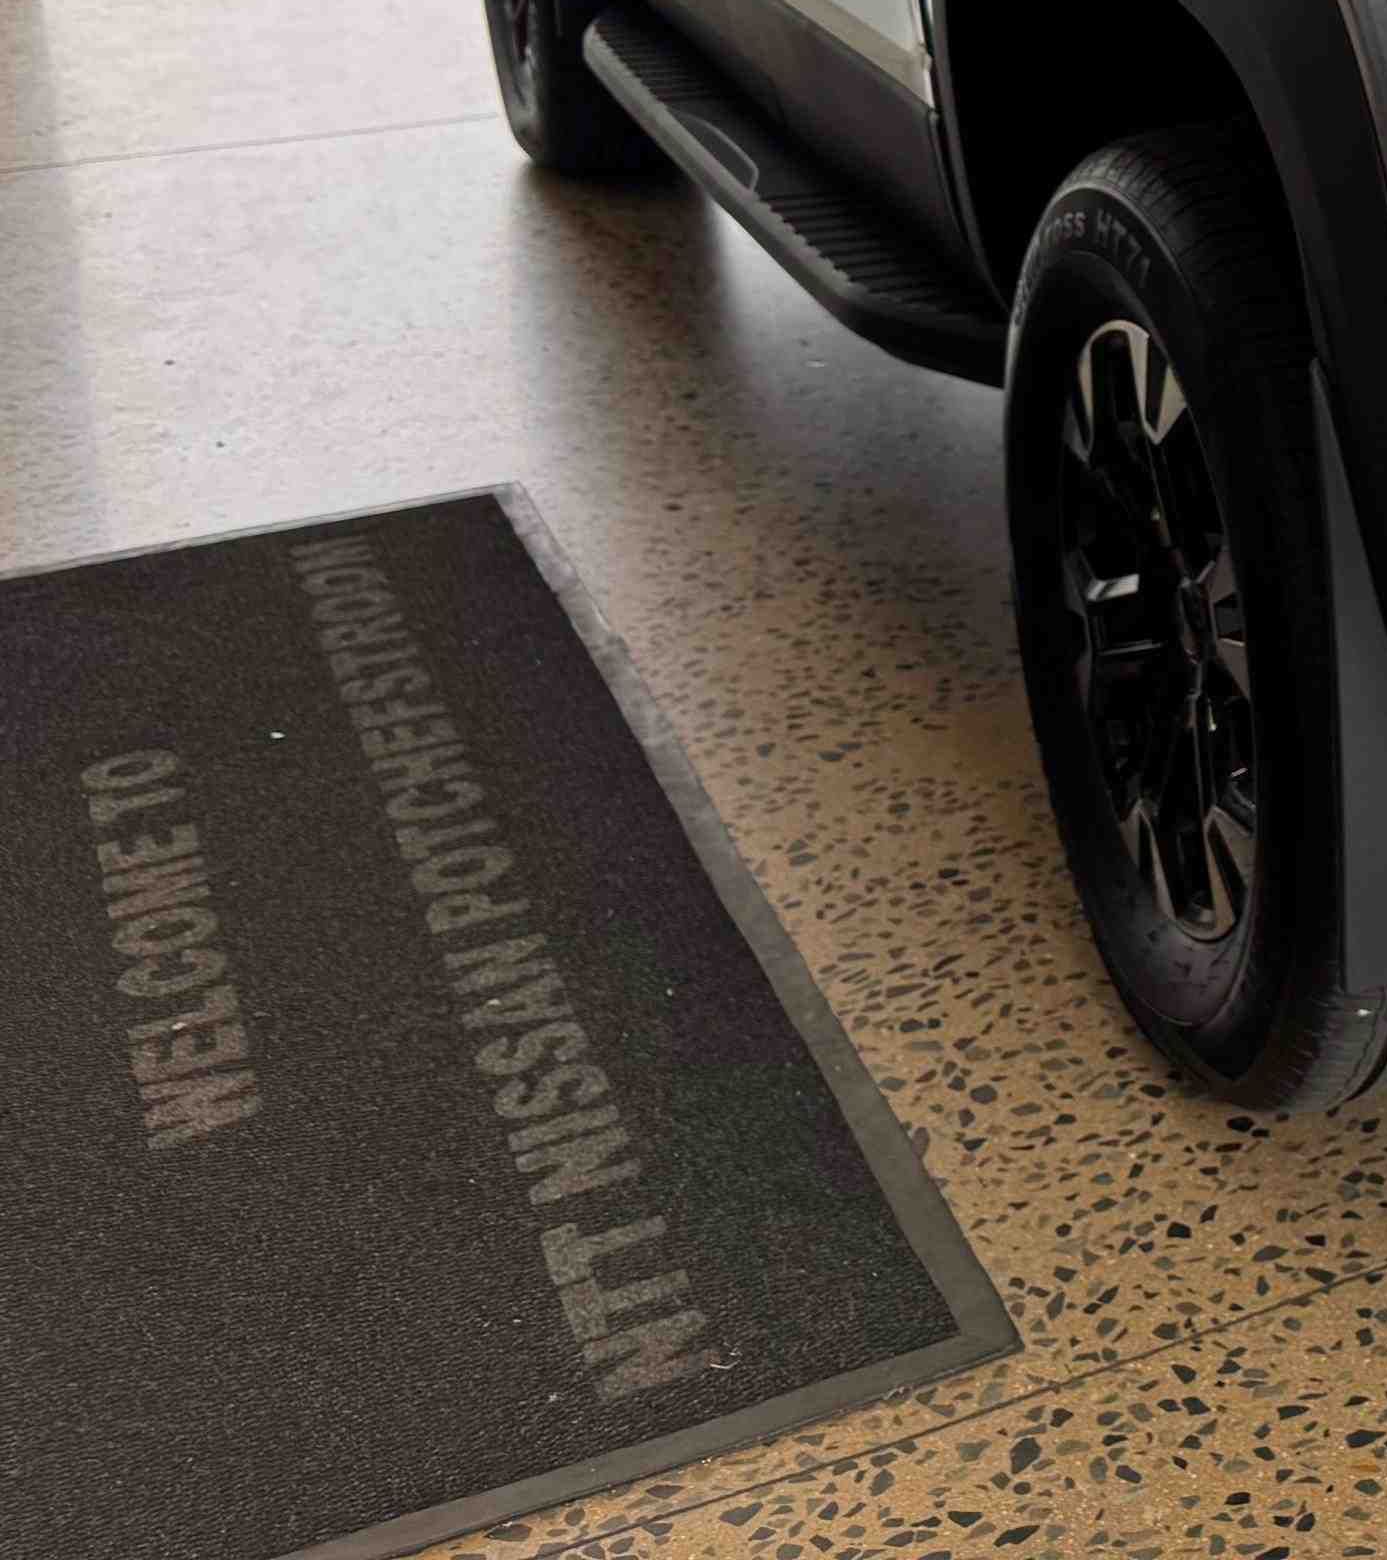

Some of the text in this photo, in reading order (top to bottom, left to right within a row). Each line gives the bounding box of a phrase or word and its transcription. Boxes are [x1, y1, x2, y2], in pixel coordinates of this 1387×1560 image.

[78, 746, 263, 1151] WELCOME TO
[288, 534, 713, 1404] NTT NISSAN POTCHEFSTROOM
